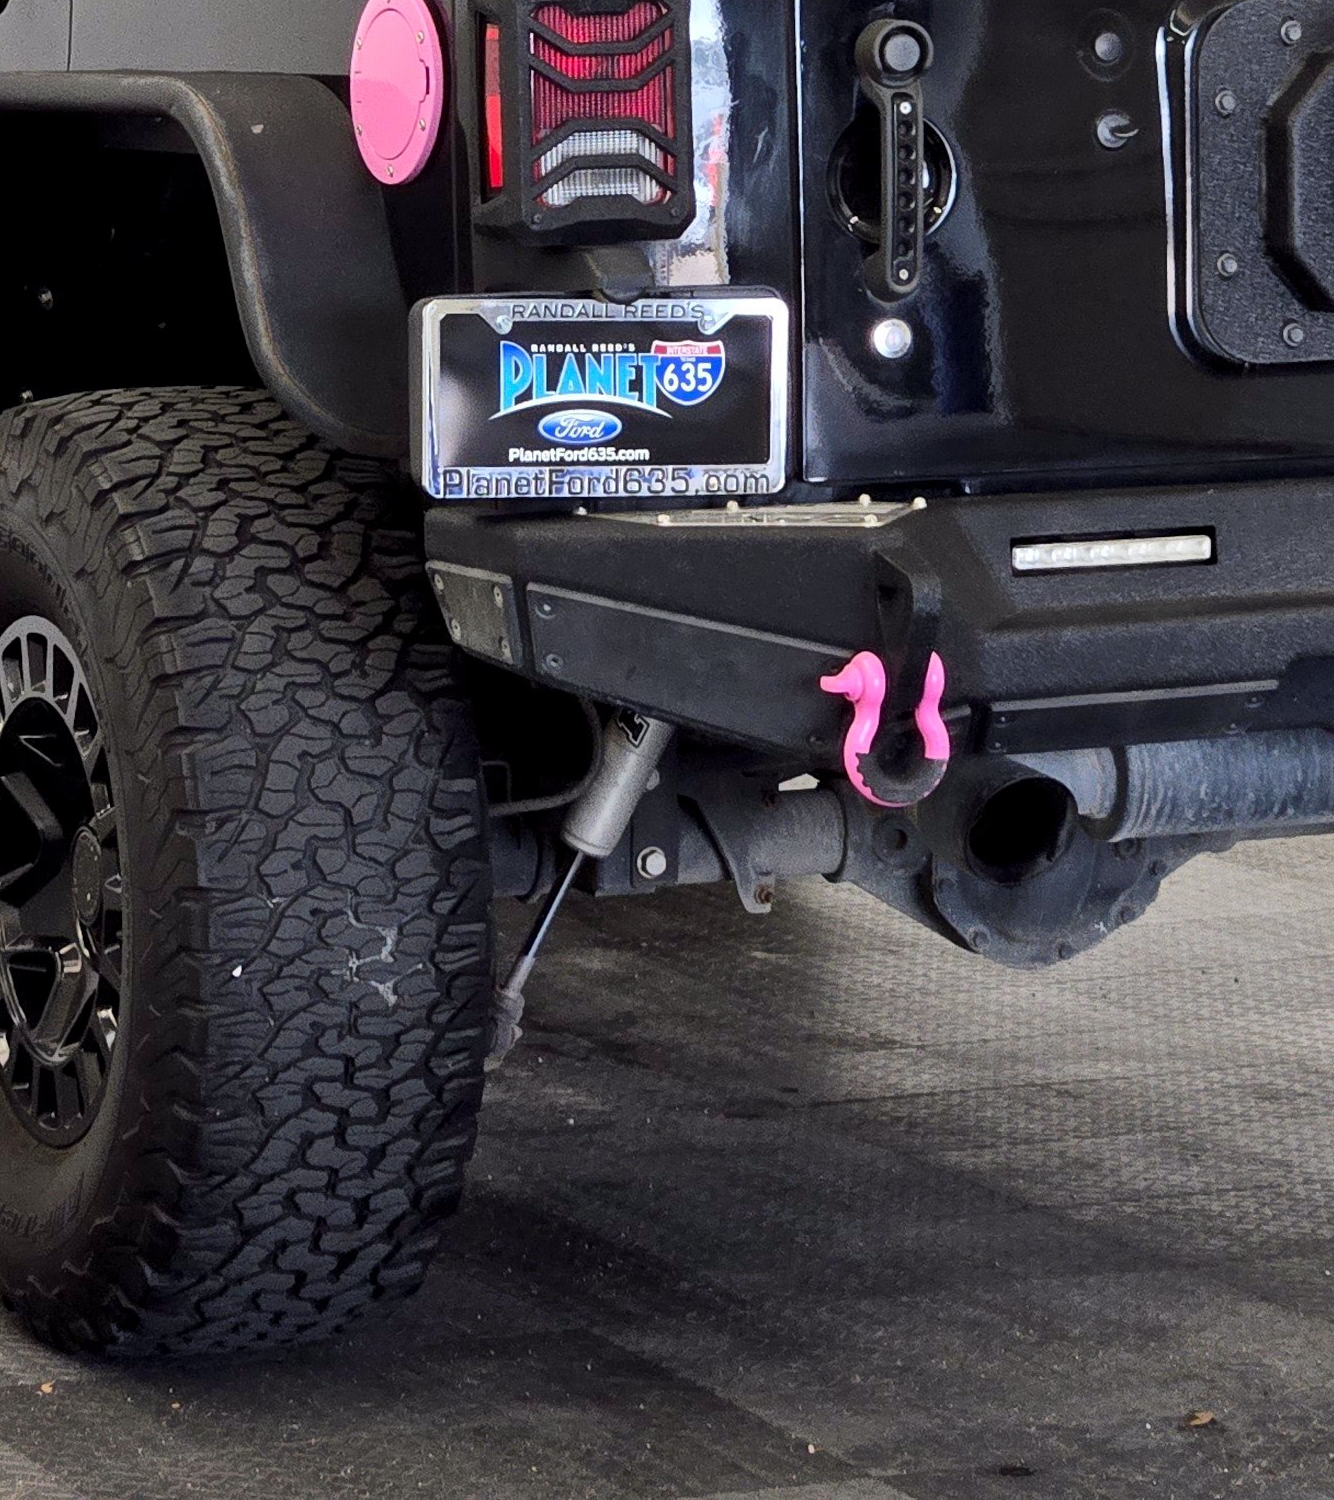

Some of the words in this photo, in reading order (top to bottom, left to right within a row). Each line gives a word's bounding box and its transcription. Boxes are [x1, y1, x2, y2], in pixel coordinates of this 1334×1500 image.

[511, 302, 617, 319] RANDALL
[623, 302, 705, 319] REED'S
[530, 343, 587, 353] RANDALL
[499, 340, 662, 414] PLANET
[663, 362, 713, 393] 635
[554, 416, 605, 439] Ford
[508, 447, 650, 463] PlanetFord635.com
[442, 467, 770, 496] PlanetFord635.com
